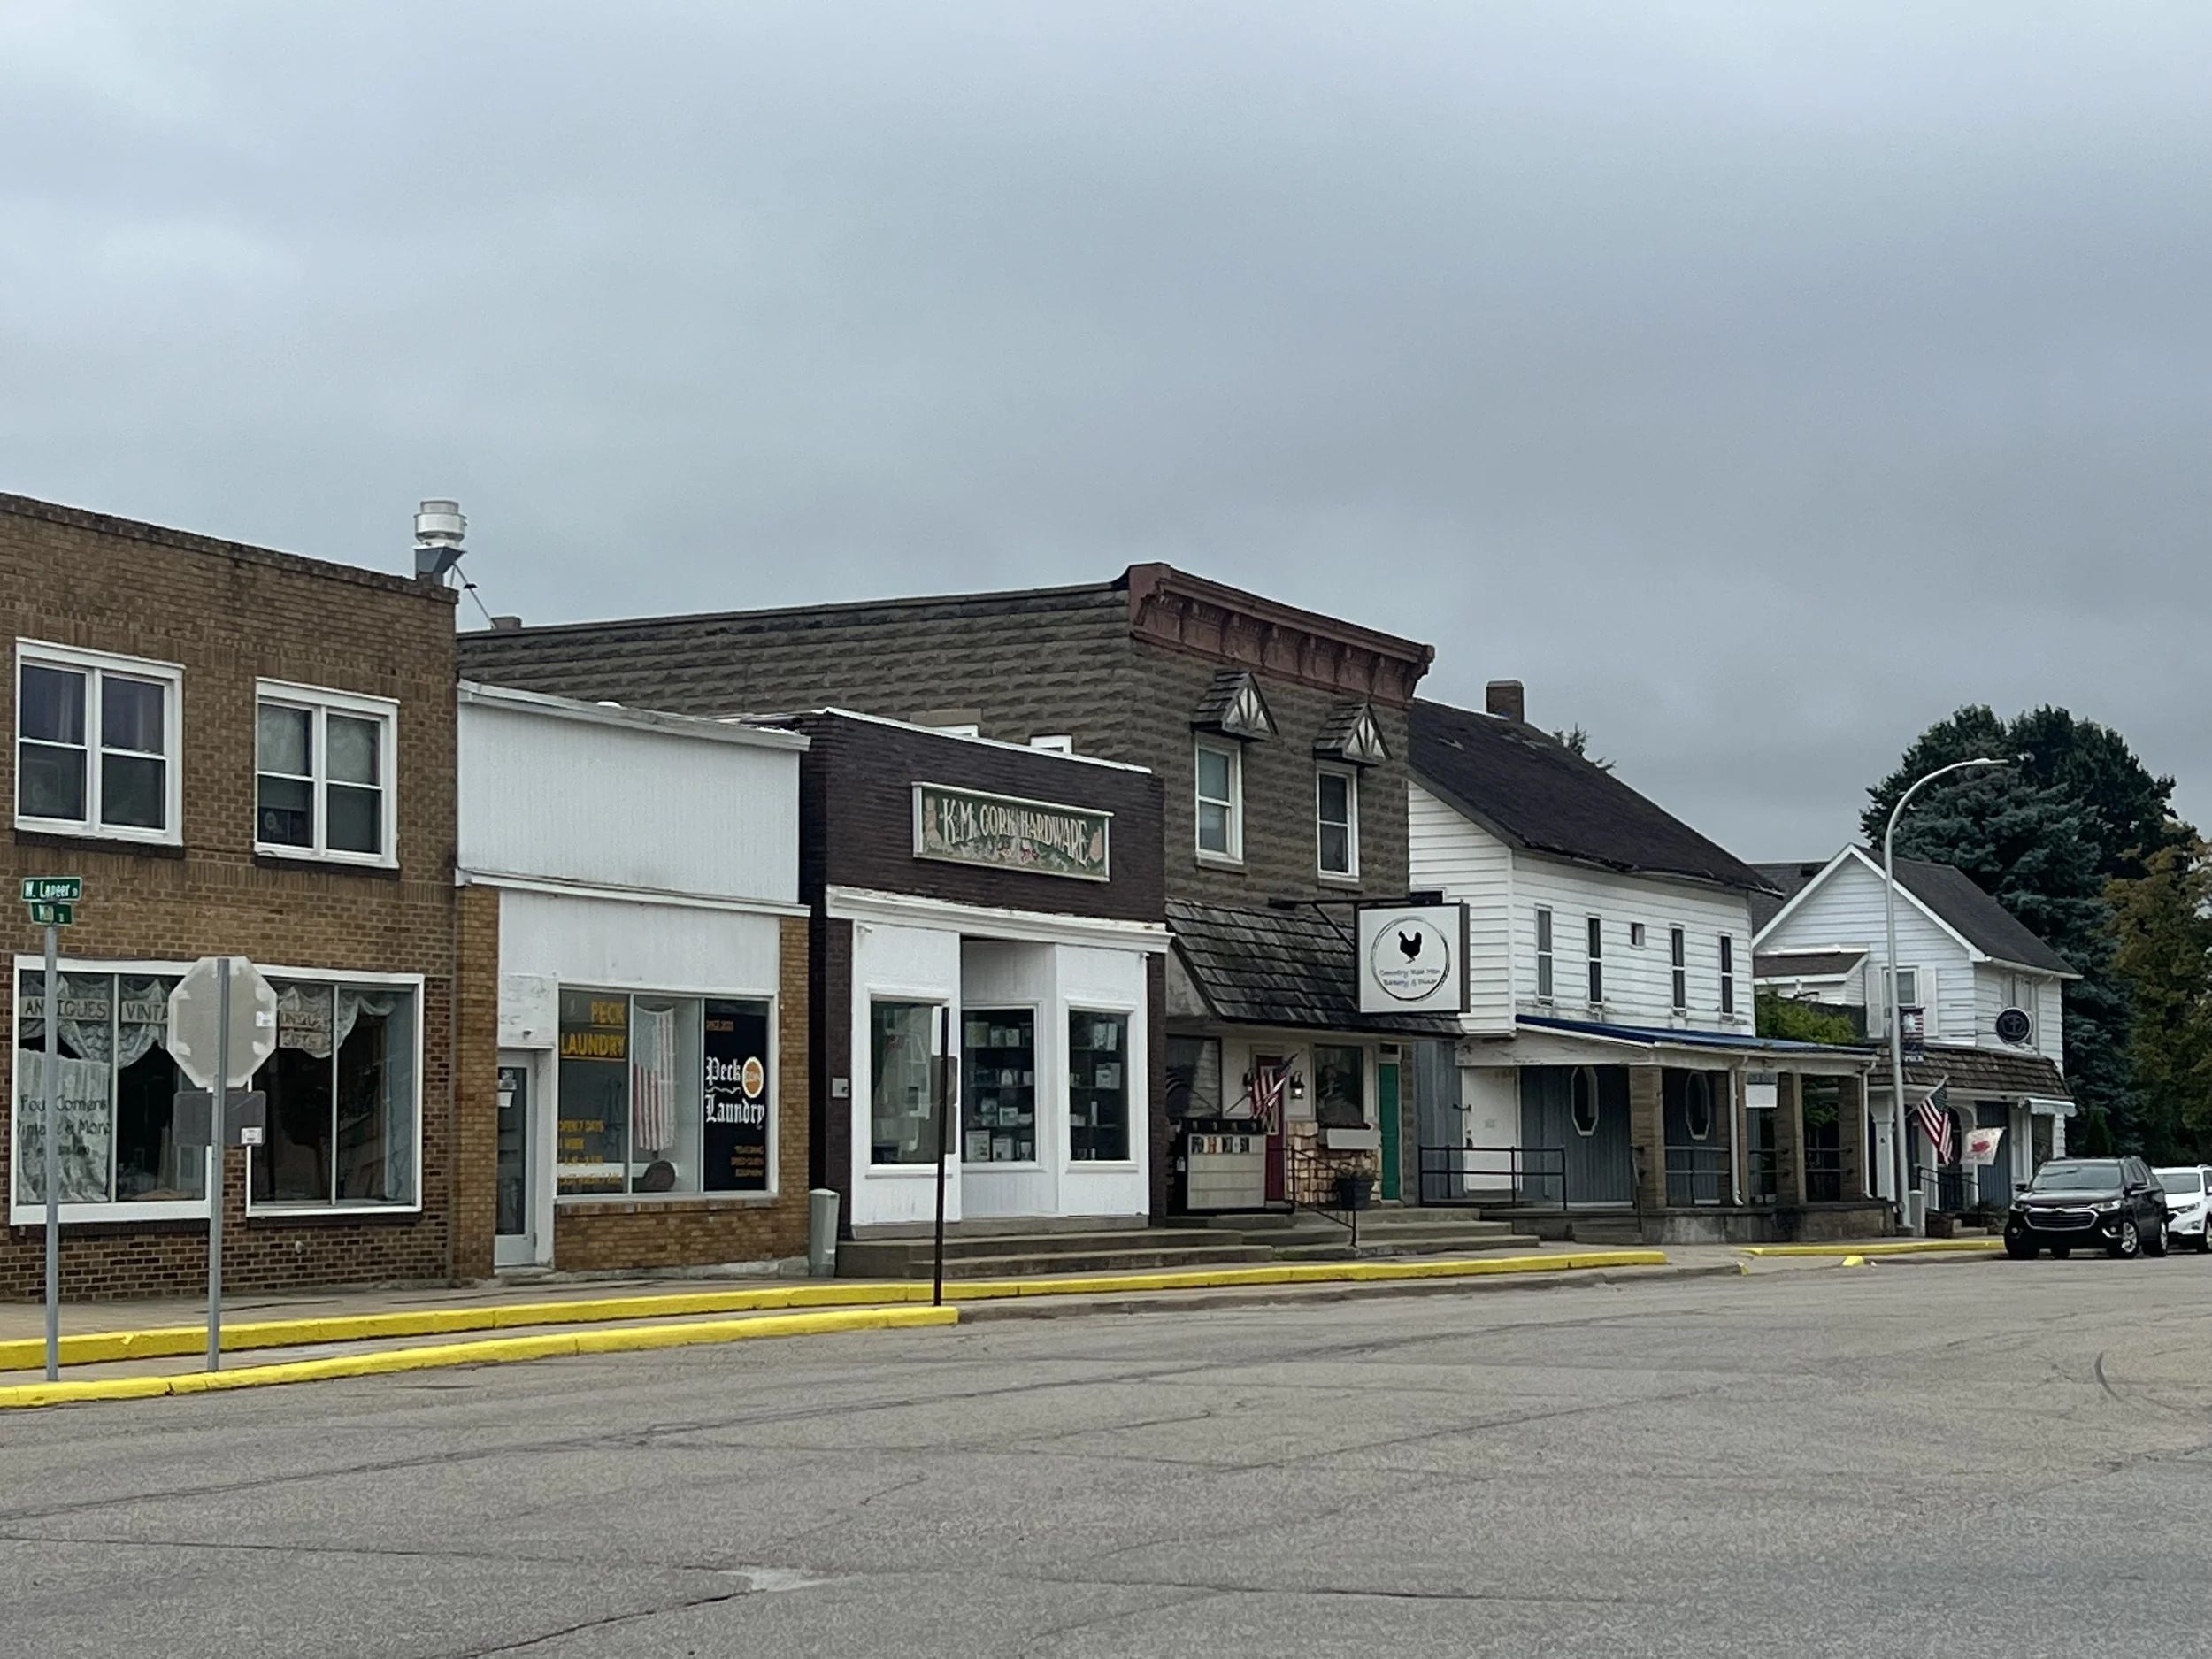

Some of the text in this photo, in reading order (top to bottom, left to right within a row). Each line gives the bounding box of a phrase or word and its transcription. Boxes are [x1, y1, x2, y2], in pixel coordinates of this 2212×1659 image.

[1020, 810, 1087, 867] HARDWARE
[25, 1000, 106, 1018] ANIQUES
[590, 1001, 626, 1024] PECK
[561, 1033, 625, 1056] LAUNDRY
[705, 1056, 741, 1086] Peck
[20, 1094, 47, 1112] Fou
[705, 1094, 764, 1130] Laundry
